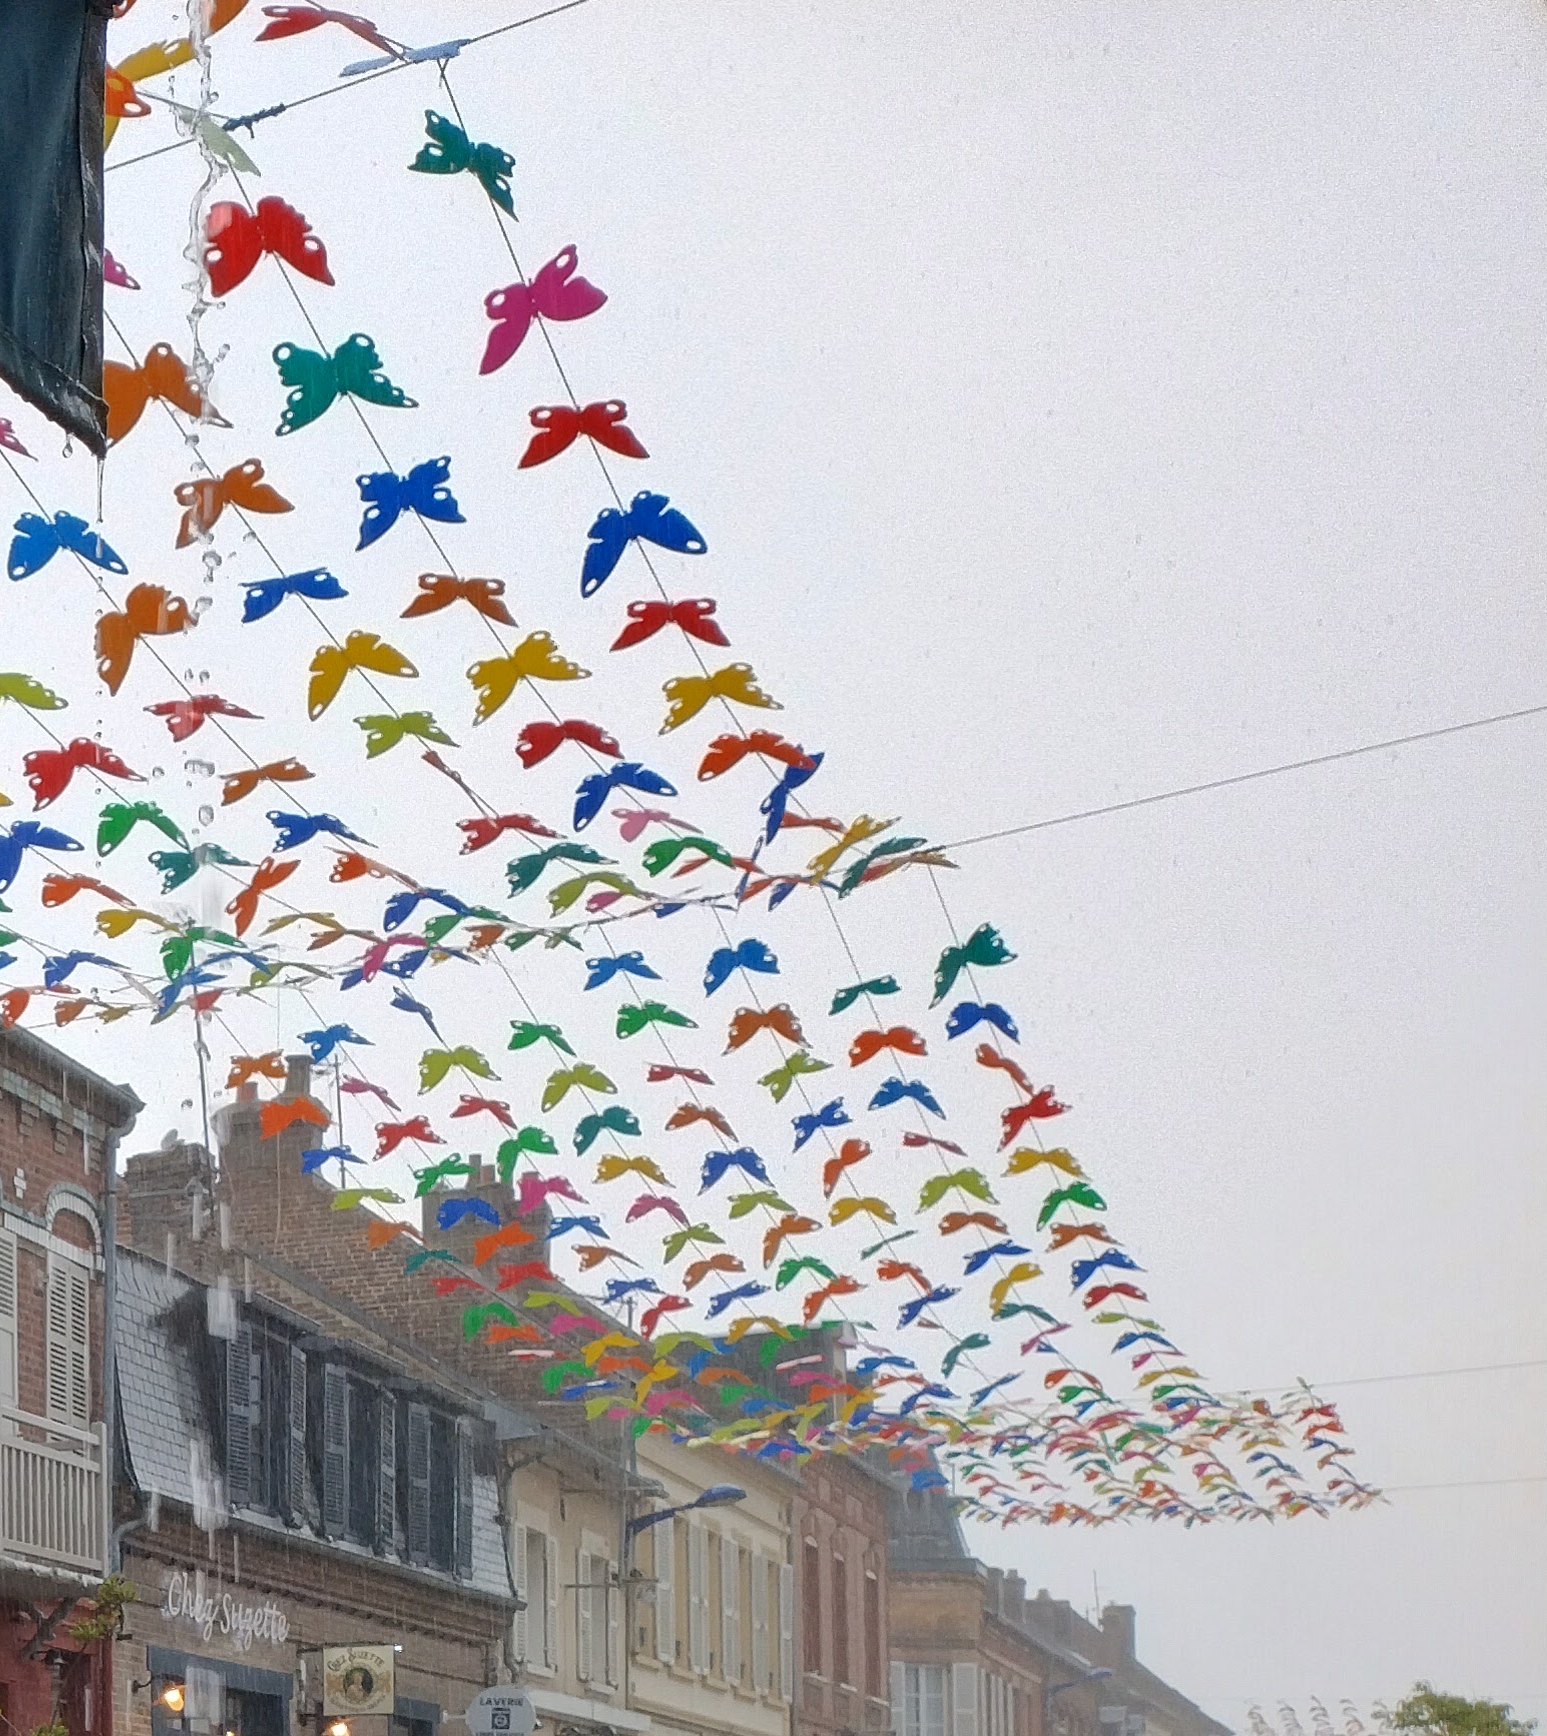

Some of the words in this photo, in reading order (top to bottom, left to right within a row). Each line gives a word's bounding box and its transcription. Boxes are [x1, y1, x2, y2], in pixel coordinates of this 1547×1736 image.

[168, 1571, 219, 1643] Chez
[220, 1593, 291, 1651] Suzette
[479, 1697, 524, 1708] LAVERIE
